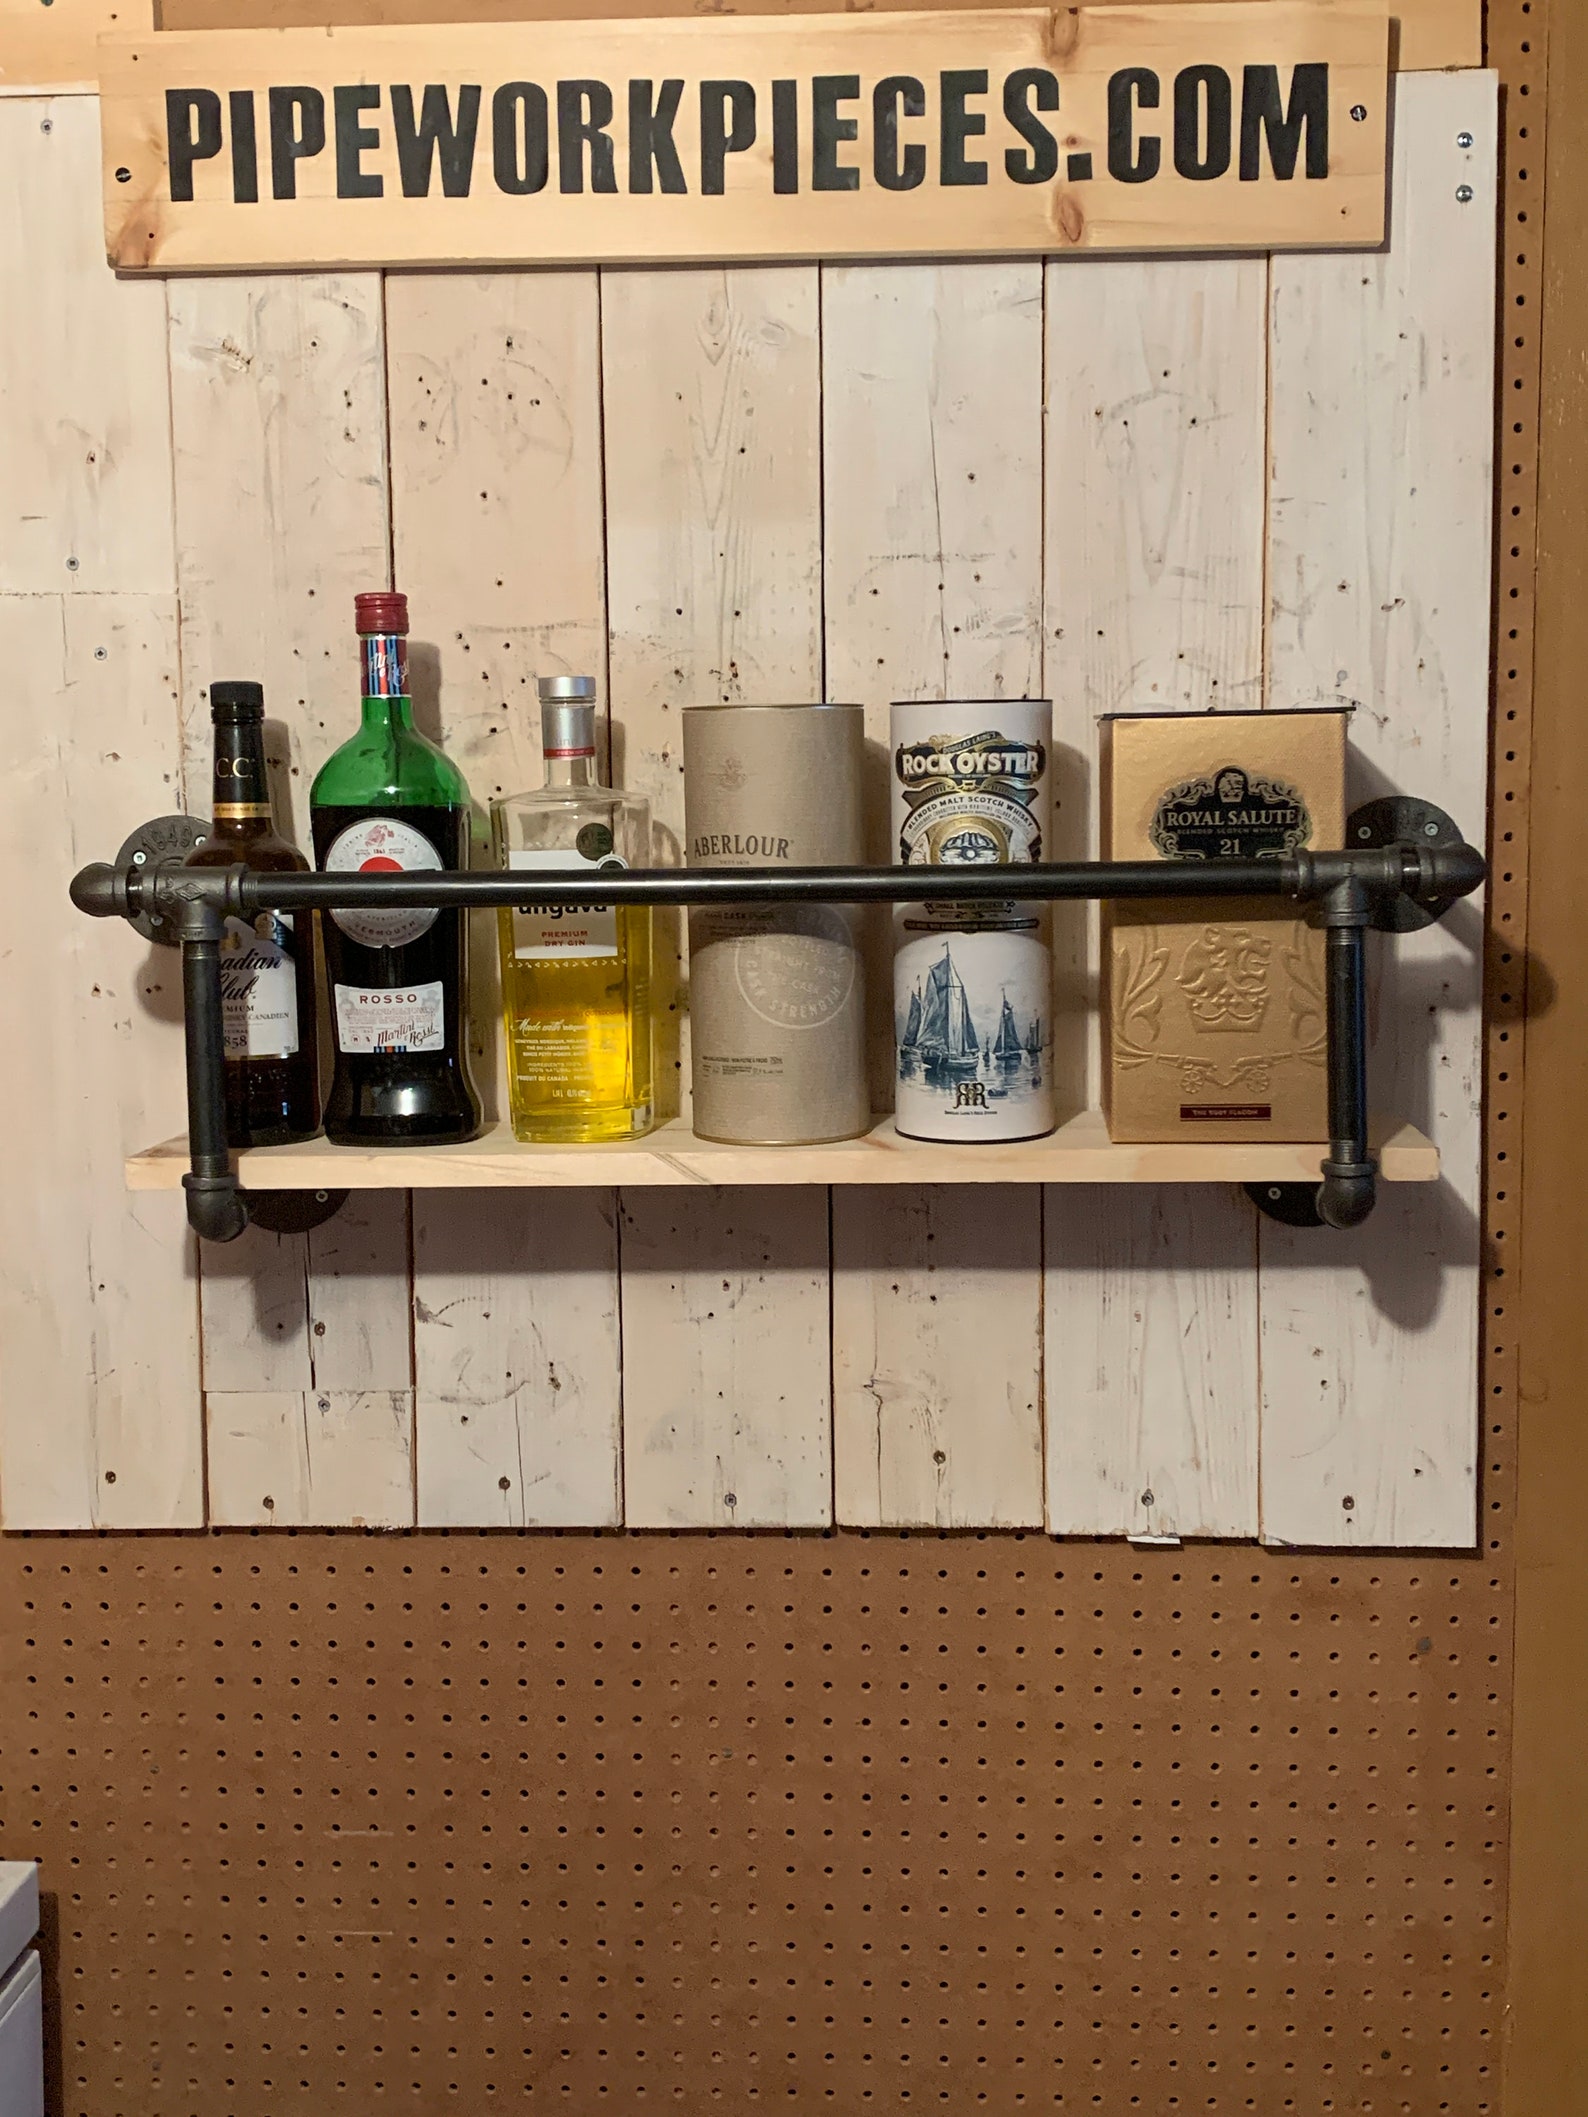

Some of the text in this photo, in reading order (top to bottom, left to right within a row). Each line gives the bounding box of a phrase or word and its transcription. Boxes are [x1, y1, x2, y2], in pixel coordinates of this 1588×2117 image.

[166, 63, 1328, 203] PIPEWORKPIECES.COM
[902, 751, 1039, 775] ROCK OYSTER
[908, 804, 938, 830] BLENDED
[940, 797, 964, 807] MALT
[968, 796, 1004, 808] SCOTCH
[1006, 803, 1033, 827] WHISKY
[1166, 809, 1296, 827] ROYAL SALUTE
[694, 834, 789, 860] ABERLOUR
[1220, 838, 1241, 855] 21
[541, 930, 588, 938] PREMIUM
[544, 939, 563, 947] DRY
[220, 947, 283, 971] adian
[359, 993, 418, 1005] ROSSO
[224, 1034, 248, 1050] 858
[377, 1020, 415, 1048] Martini
